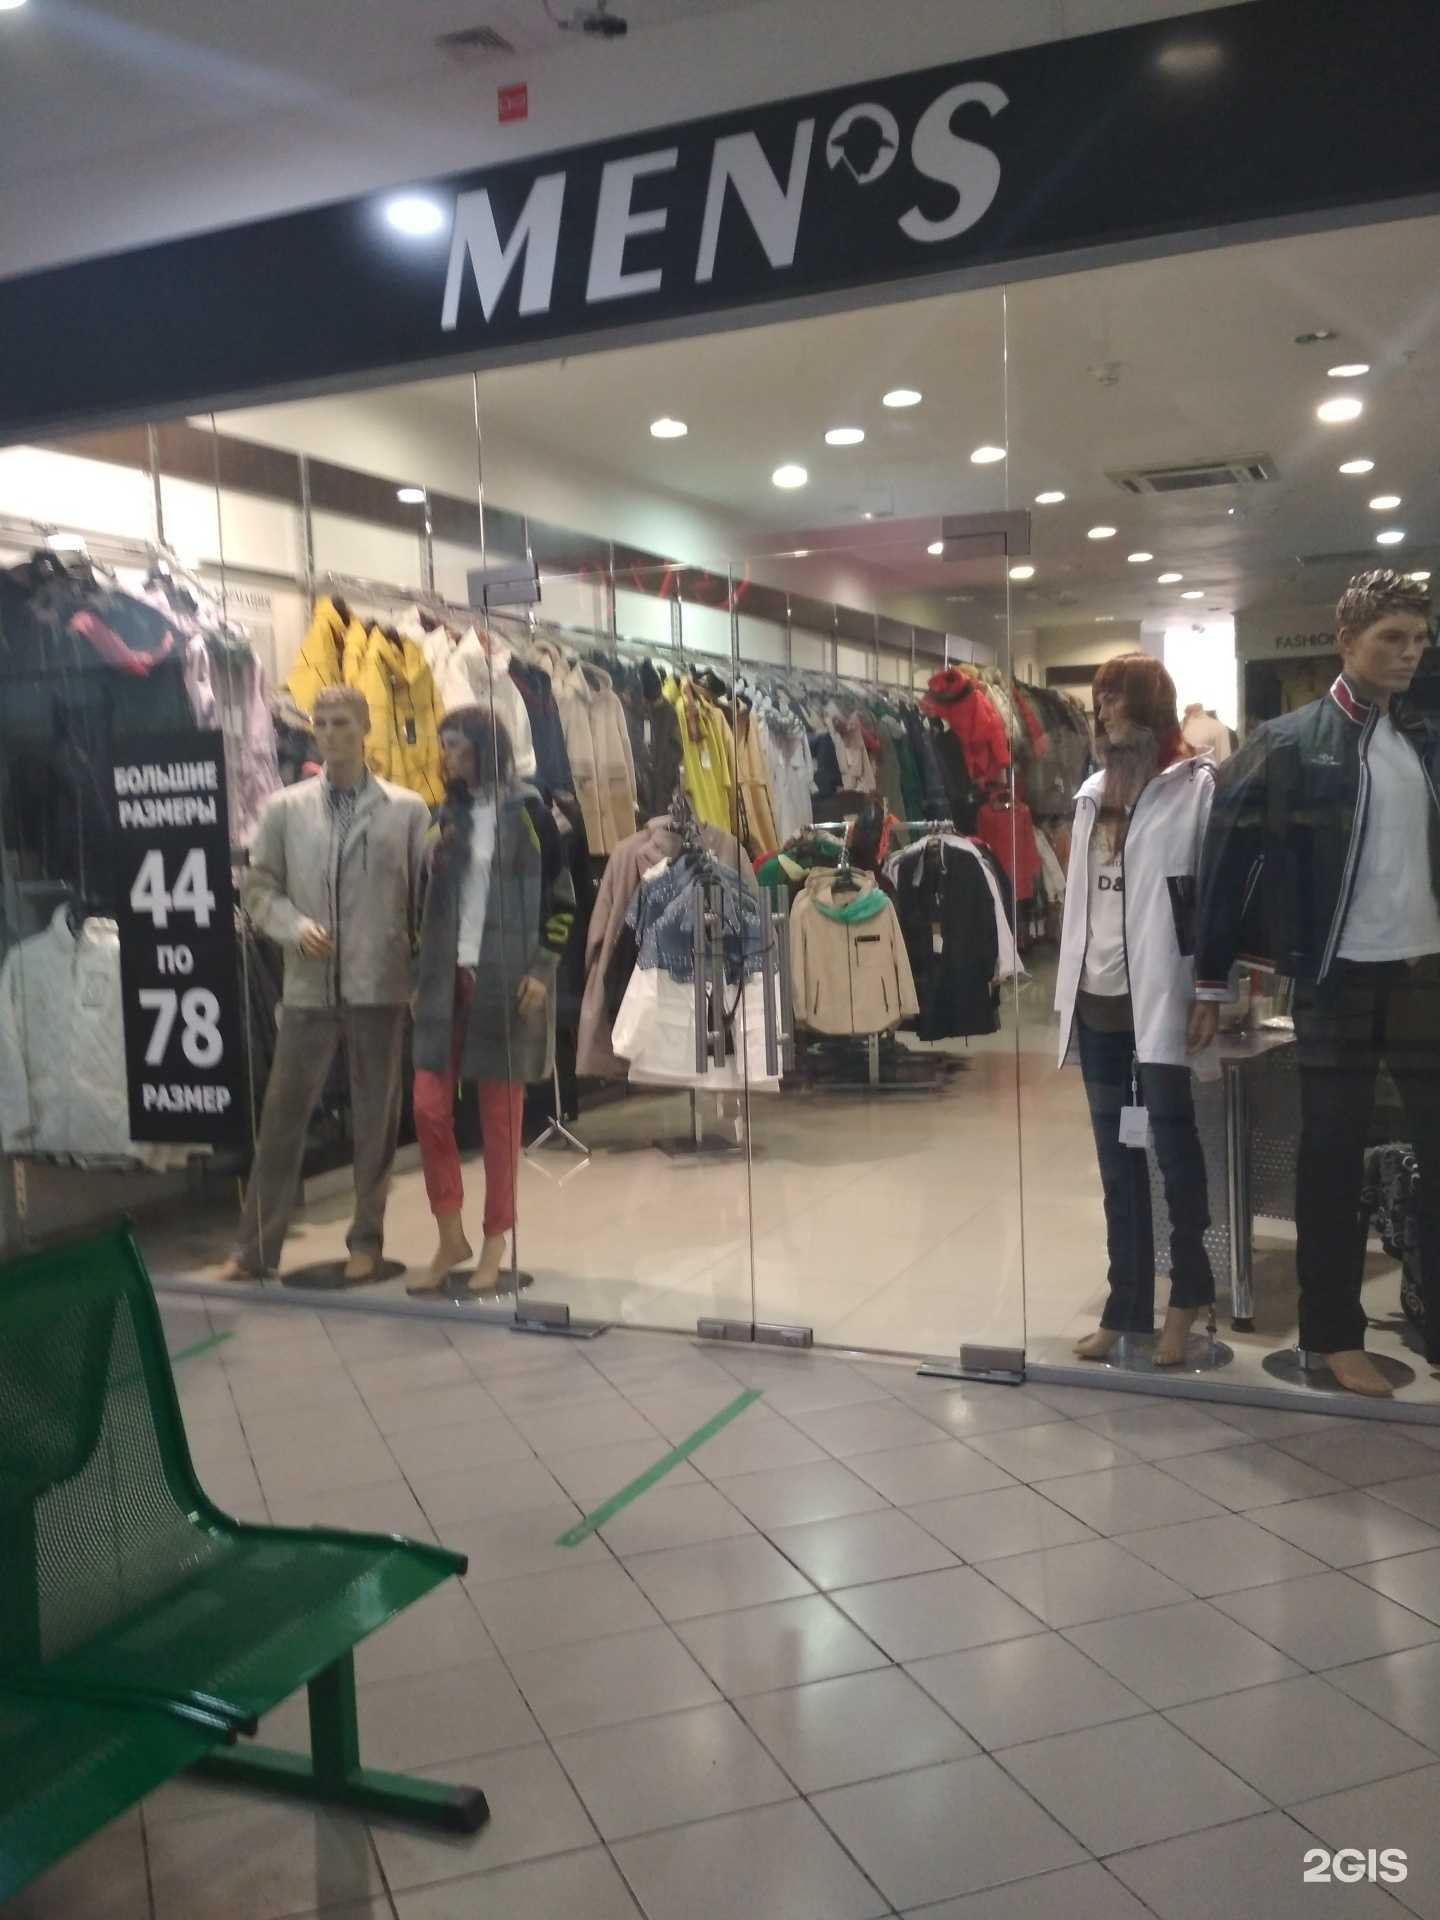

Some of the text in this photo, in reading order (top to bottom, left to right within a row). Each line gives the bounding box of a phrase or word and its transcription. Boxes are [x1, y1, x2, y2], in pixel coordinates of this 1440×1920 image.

[113, 760, 218, 796] БОЛЬШИЕ
[118, 796, 217, 828] РАЗМЕРЫ
[130, 847, 216, 929] 44
[138, 987, 224, 1068] 78
[142, 1082, 232, 1113] РАЗМЕР
